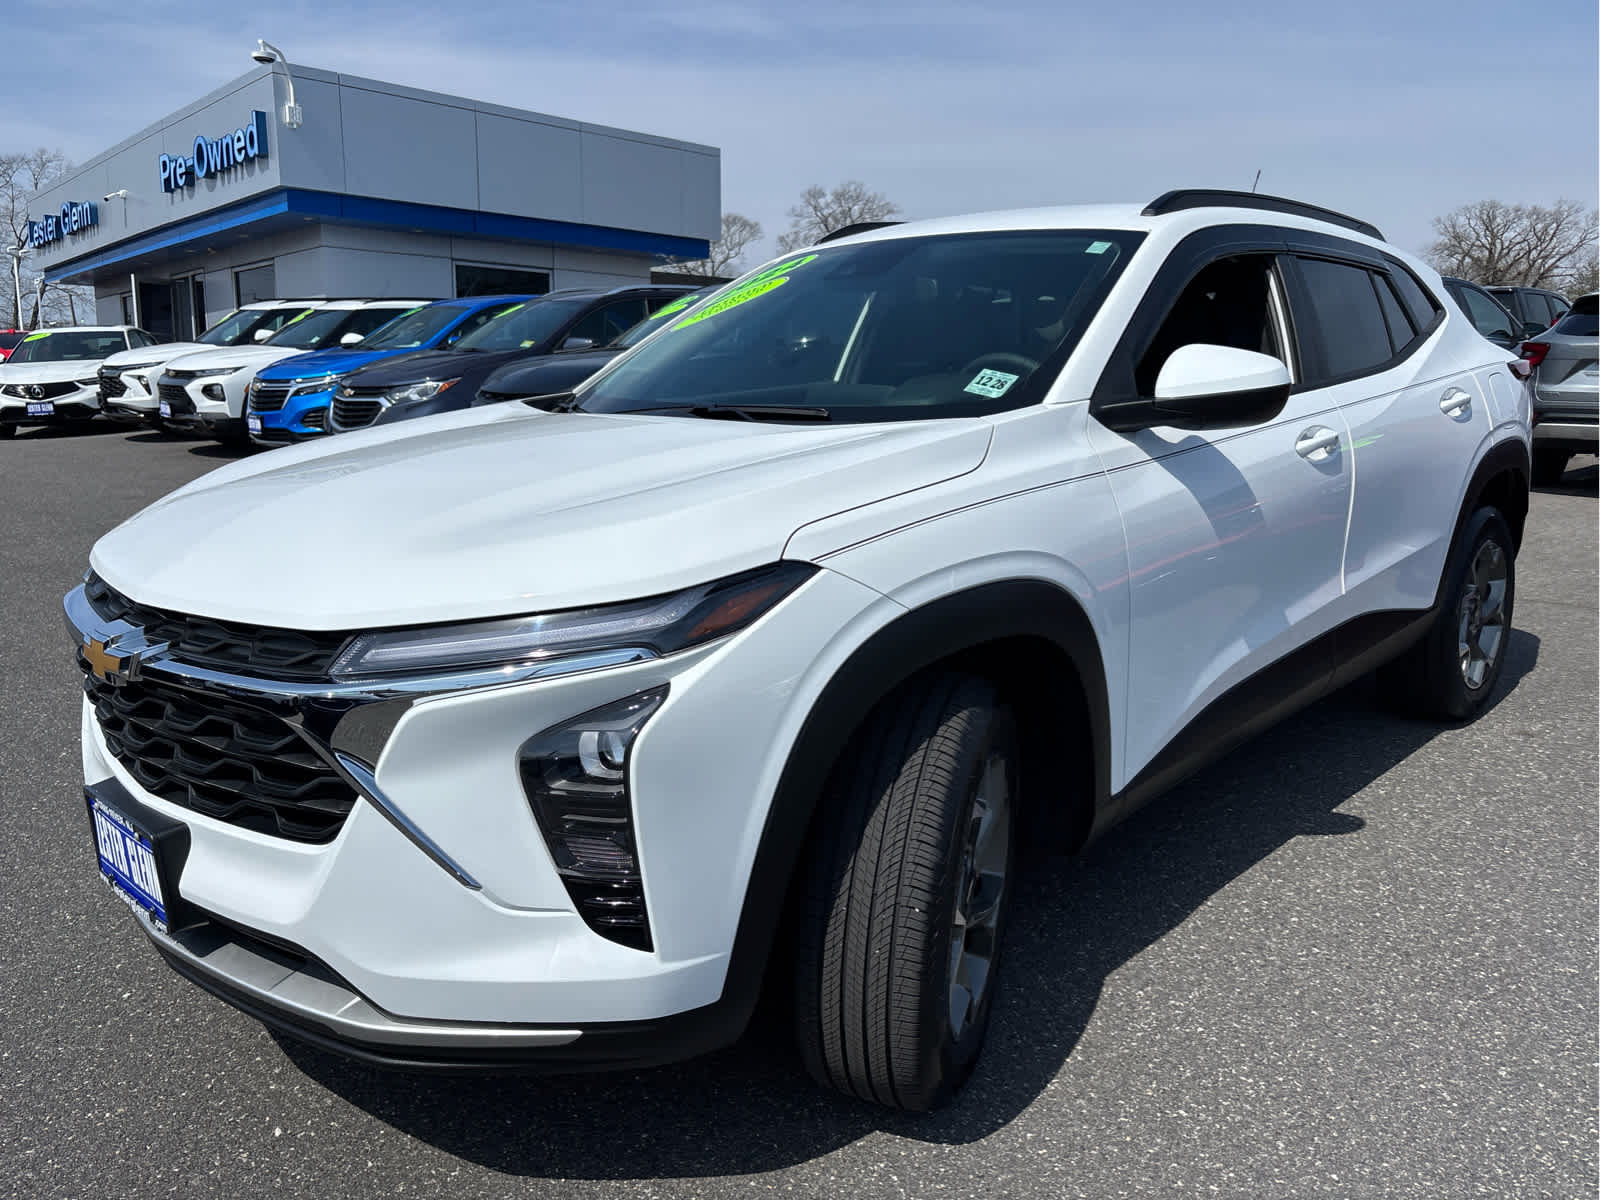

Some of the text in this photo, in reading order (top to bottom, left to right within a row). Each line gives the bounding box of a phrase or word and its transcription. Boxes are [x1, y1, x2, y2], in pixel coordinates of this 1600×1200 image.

[159, 110, 264, 193] Pre-Owned
[28, 201, 95, 249] Lester Glenn
[975, 376, 993, 386] 12
[93, 809, 164, 906] LESTER GLENN
